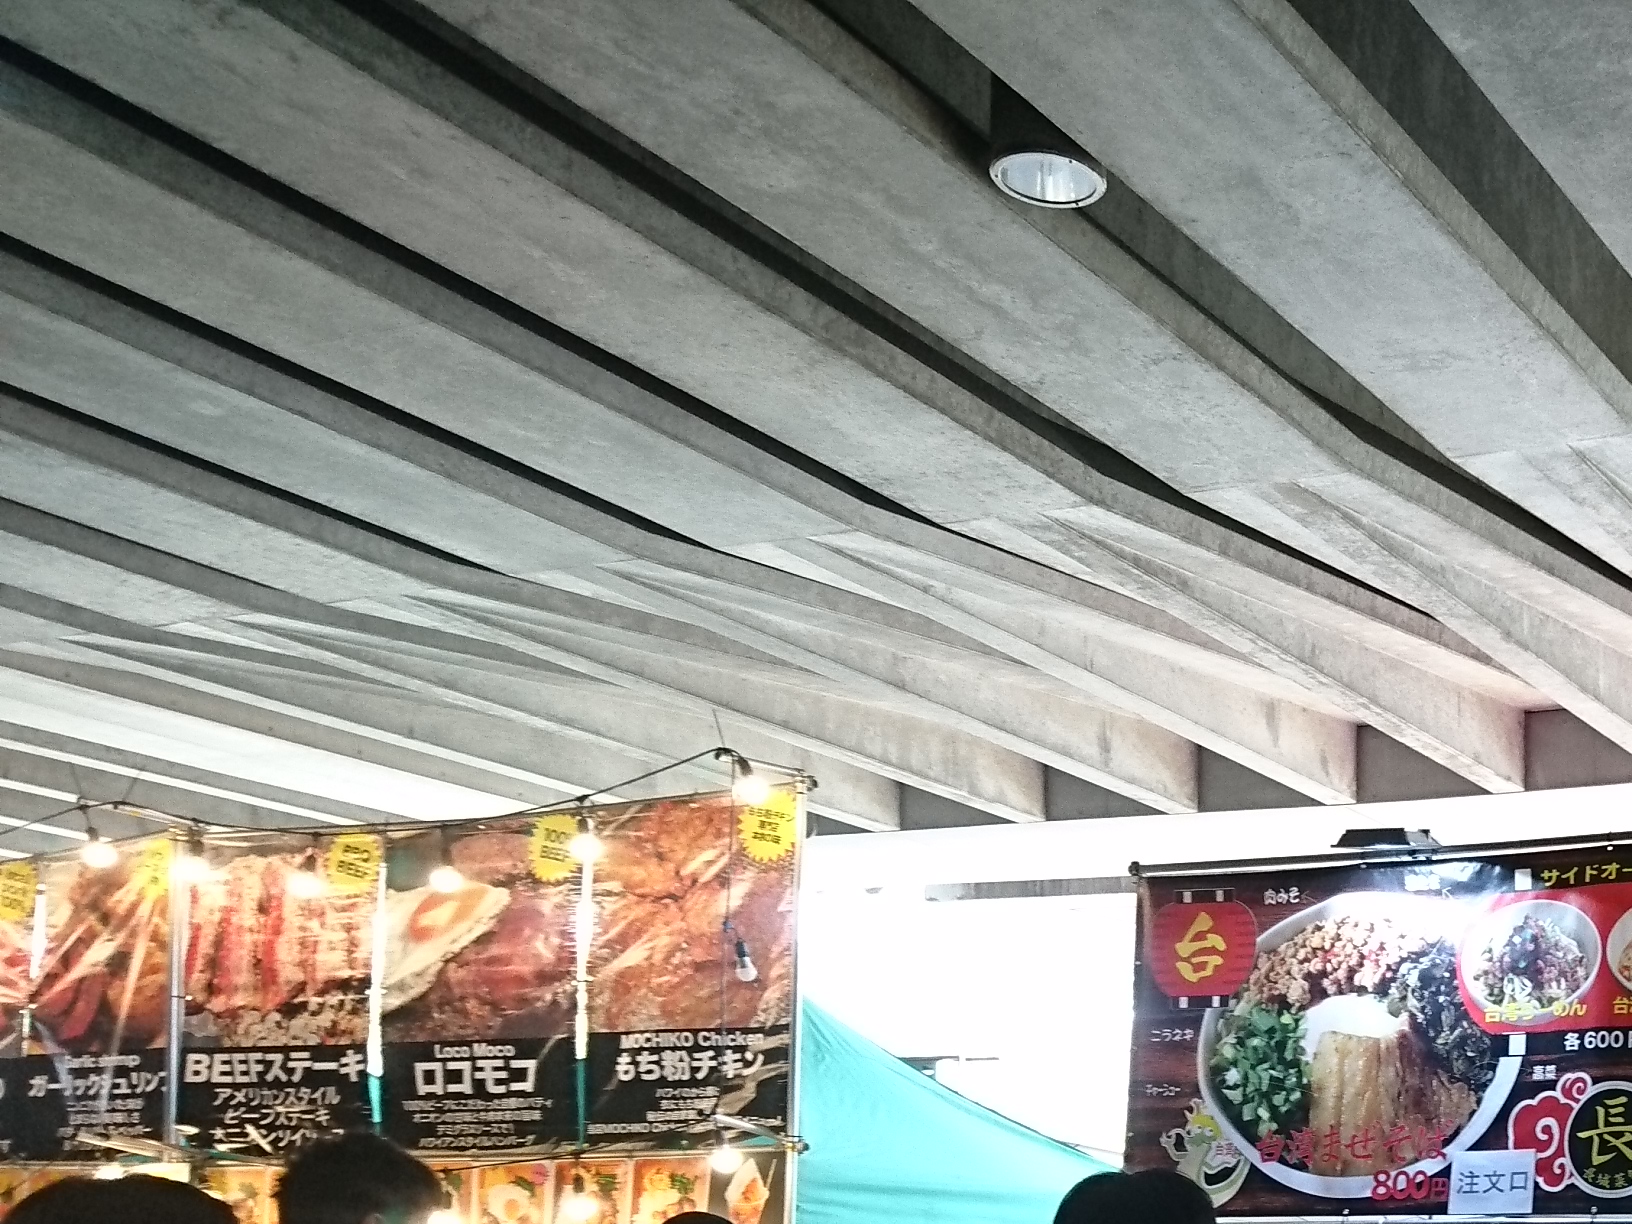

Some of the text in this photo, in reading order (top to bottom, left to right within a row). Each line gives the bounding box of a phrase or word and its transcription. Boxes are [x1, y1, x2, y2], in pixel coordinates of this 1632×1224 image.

[1174, 911, 1228, 983] 台
[433, 1042, 516, 1058] Loco Moco
[619, 1030, 765, 1049] MOCHIKO Chicken
[183, 1049, 366, 1083] BEEFステーキ
[413, 1058, 539, 1096] ロコモコ
[615, 1050, 766, 1082] もち粉チキン
[1371, 1169, 1450, 1200] 800円
[1456, 1169, 1529, 1195] 注文口
